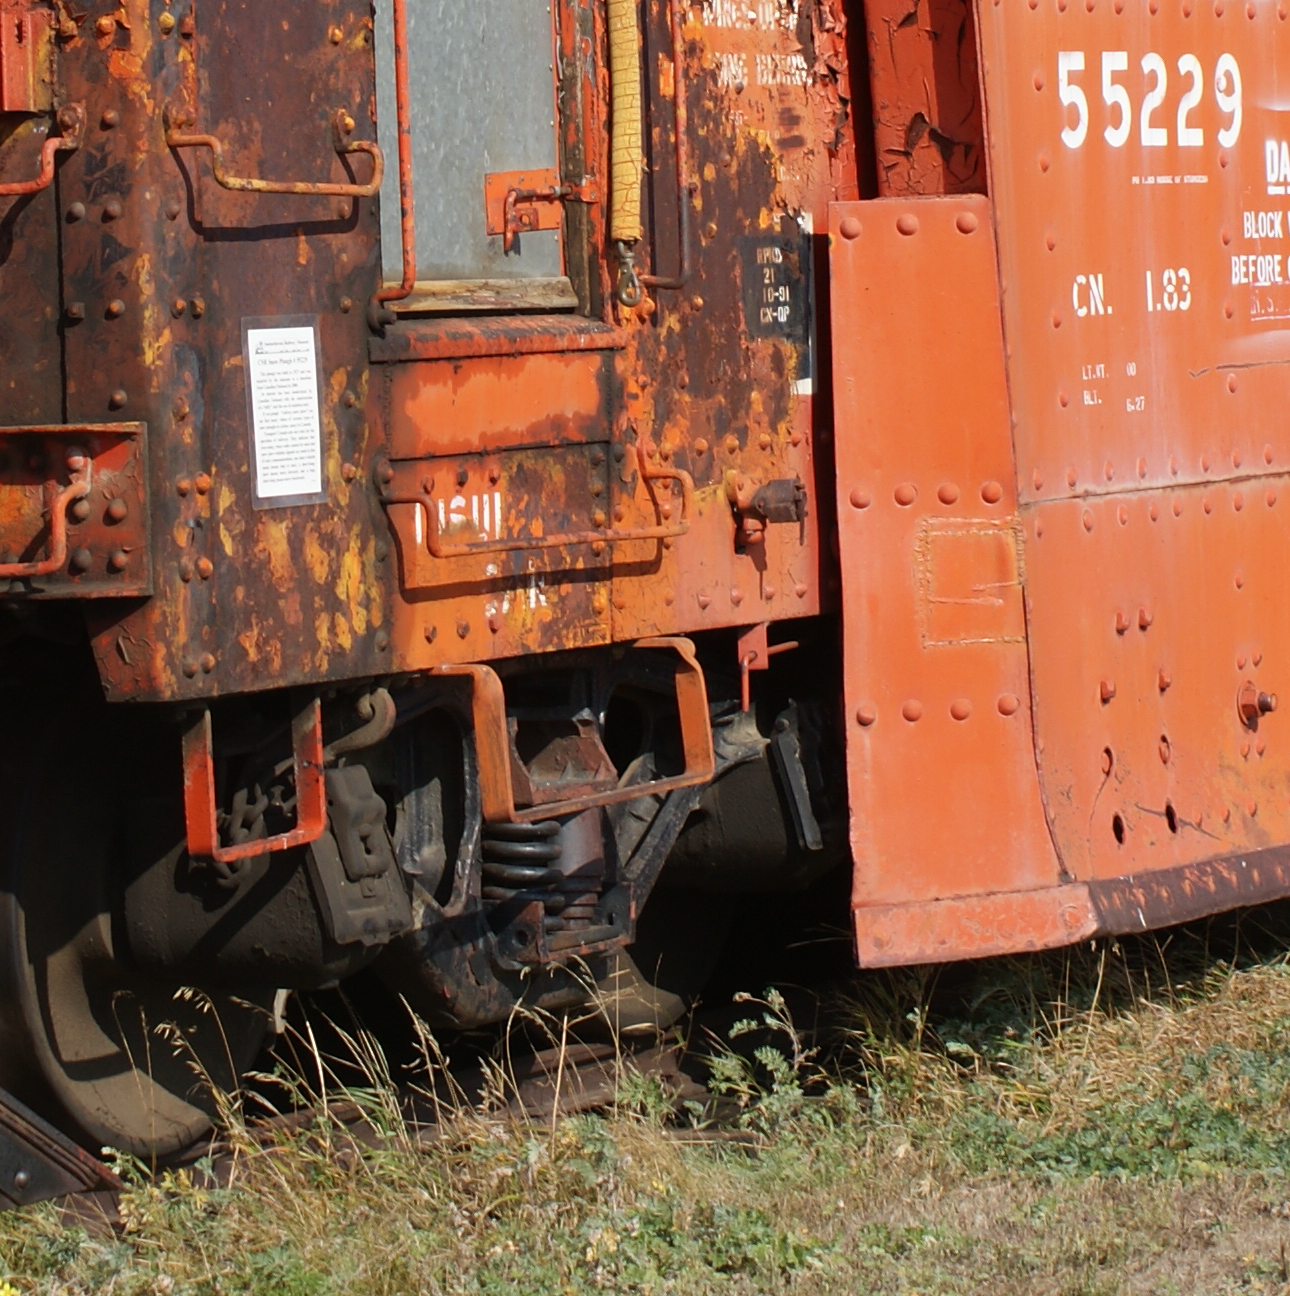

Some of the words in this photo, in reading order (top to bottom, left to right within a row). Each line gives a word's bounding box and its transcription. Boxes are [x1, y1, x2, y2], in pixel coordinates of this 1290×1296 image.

[1058, 50, 1242, 149] 55229
[1244, 211, 1283, 238] BLOCK
[1231, 254, 1282, 284] BEFORE
[1146, 267, 1191, 312] 1.83
